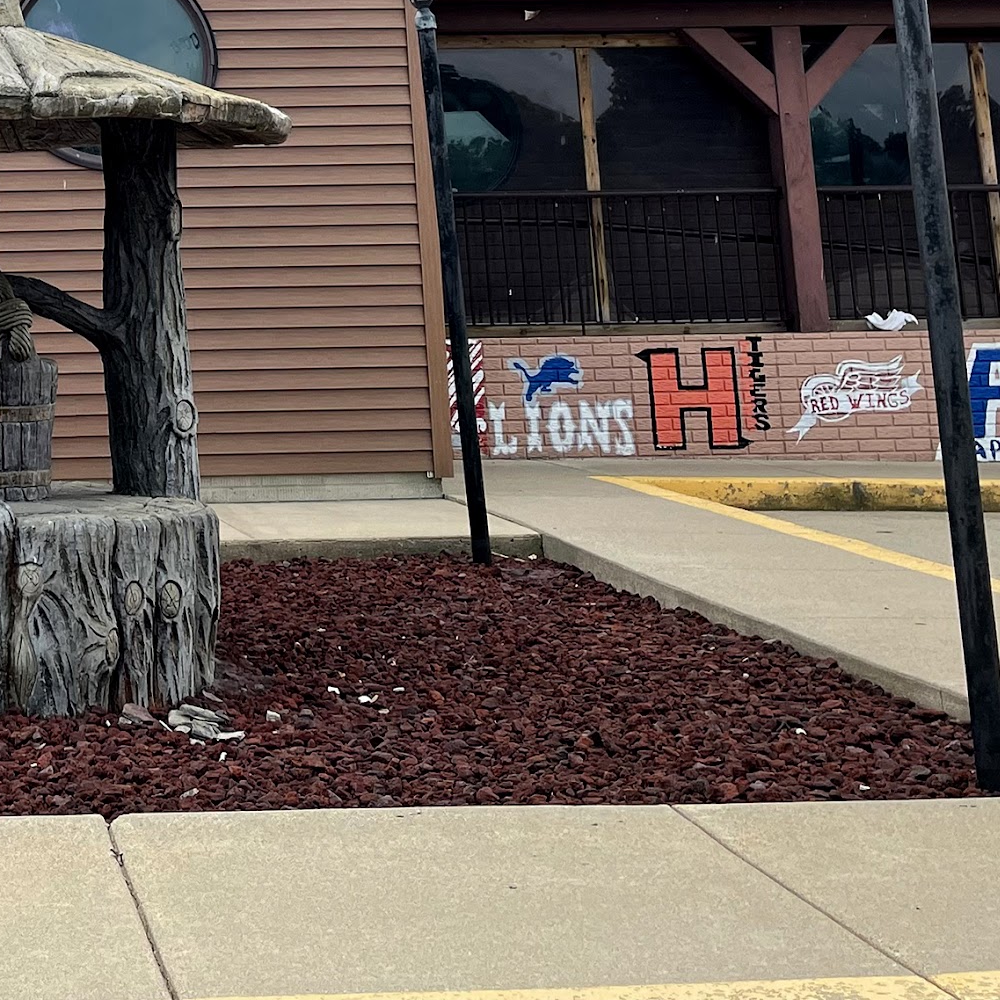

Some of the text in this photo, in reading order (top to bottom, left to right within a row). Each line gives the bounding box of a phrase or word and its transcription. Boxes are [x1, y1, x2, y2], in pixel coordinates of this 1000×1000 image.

[634, 347, 754, 451] H
[745, 336, 771, 431] TIGERS
[810, 389, 910, 413] RED WINGS
[488, 399, 636, 456] LIONS
